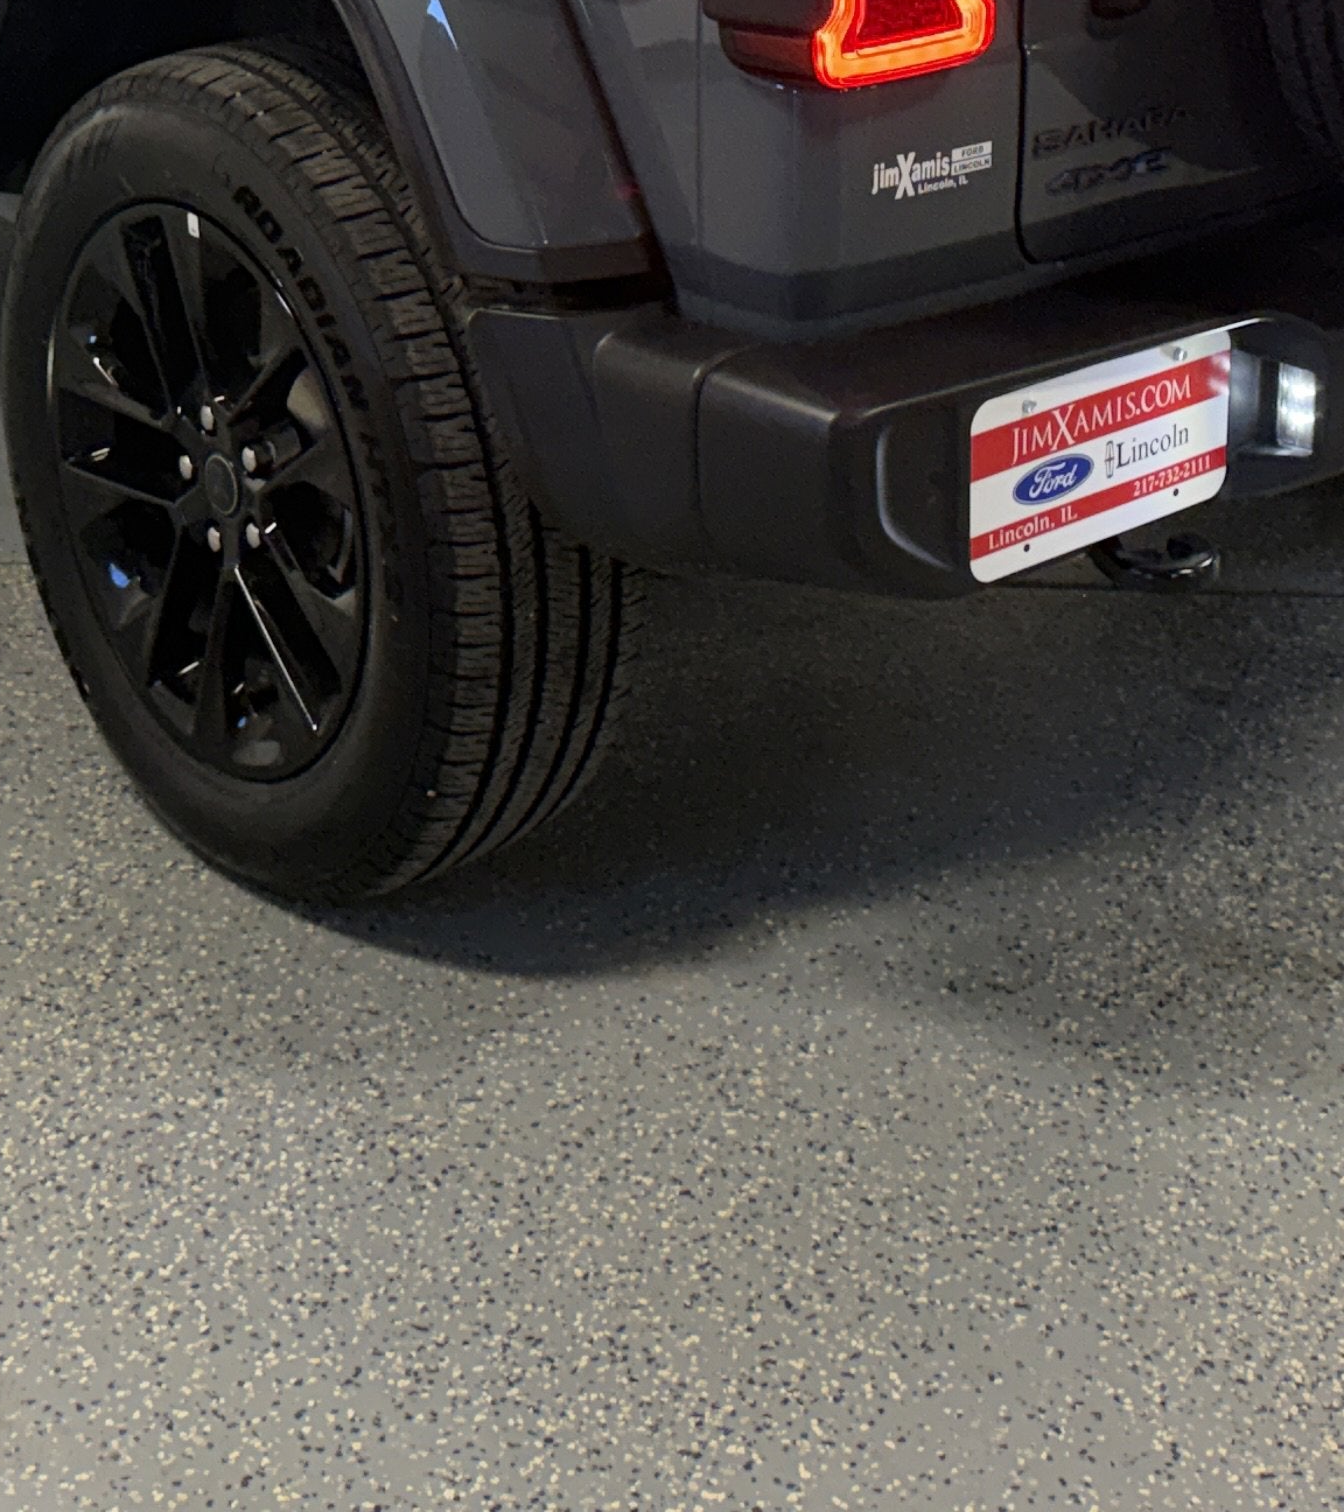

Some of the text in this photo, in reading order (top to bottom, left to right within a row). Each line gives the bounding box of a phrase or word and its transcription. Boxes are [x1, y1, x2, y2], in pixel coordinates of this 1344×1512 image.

[1010, 374, 1193, 465] JIMXAMIS.COM
[1116, 423, 1190, 469] Lincoln
[1028, 462, 1078, 499] Ford
[1132, 454, 1212, 498] 217-732-2111
[1060, 506, 1078, 525] IL
